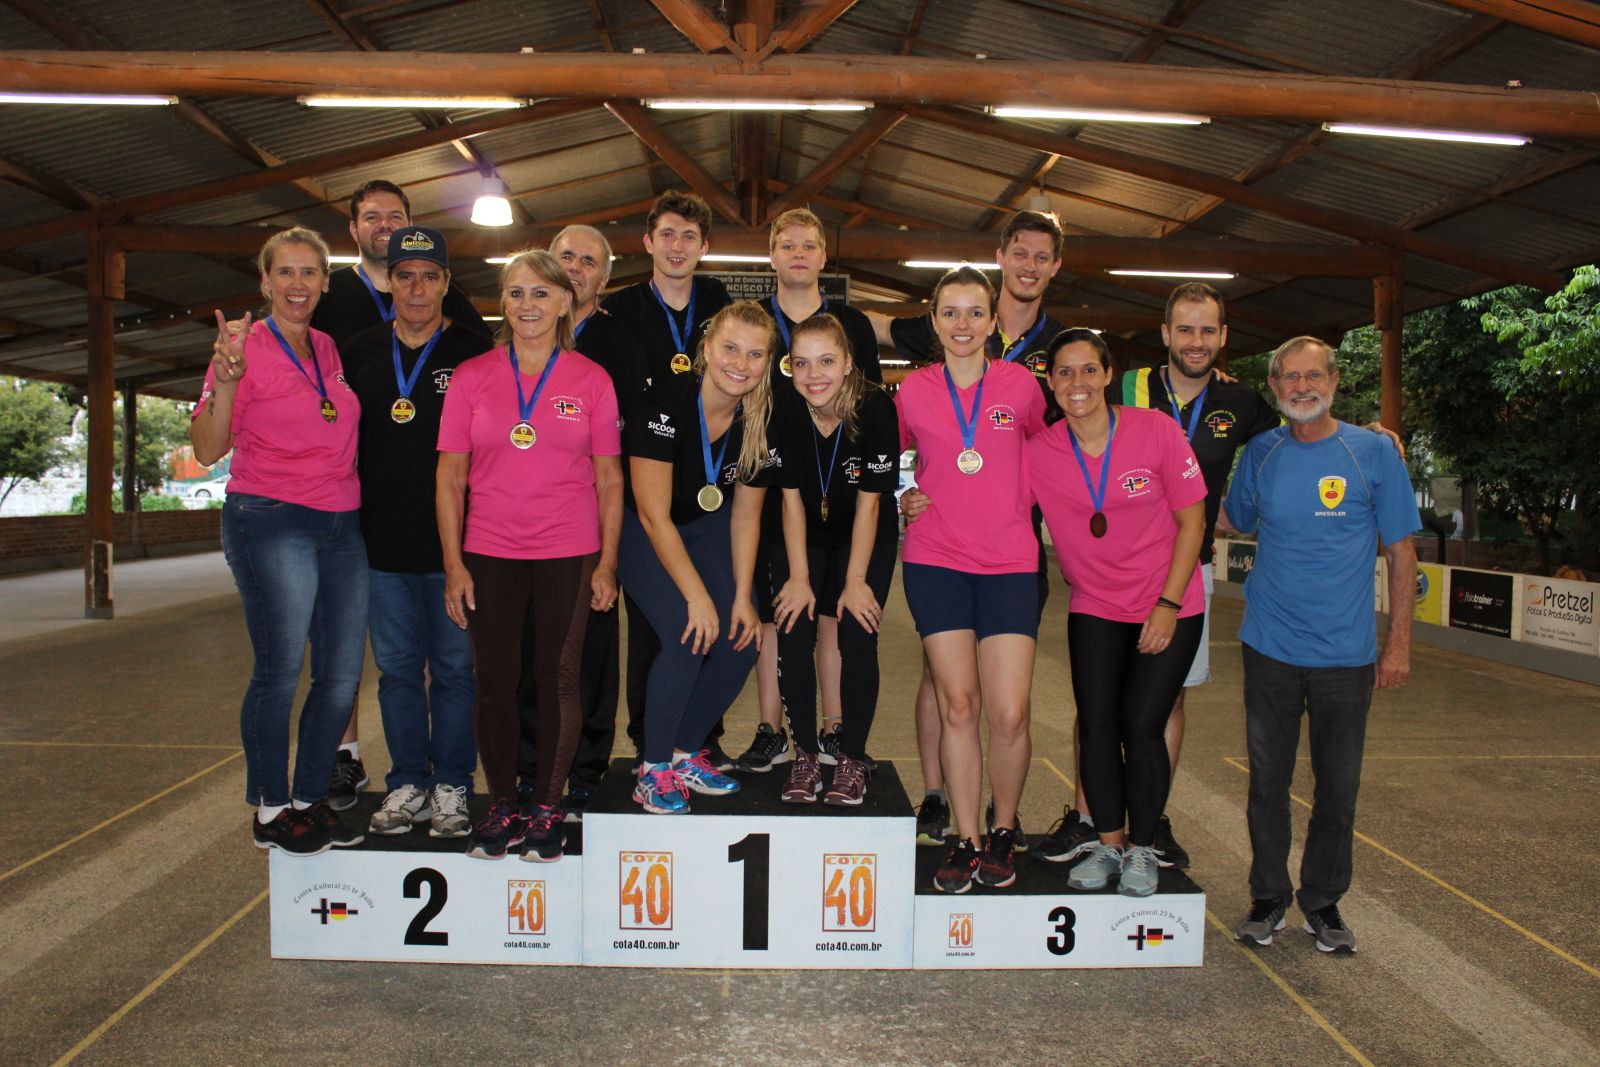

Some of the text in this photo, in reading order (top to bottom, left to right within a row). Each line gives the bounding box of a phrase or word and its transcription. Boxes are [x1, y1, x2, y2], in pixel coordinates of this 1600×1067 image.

[726, 284, 763, 292] NCISCO
[648, 421, 676, 434] SICOOB
[867, 461, 893, 470] SICOOB
[1543, 585, 1594, 613] Pretzel
[1527, 606, 1593, 625] Fotos & Produção Digital
[622, 855, 670, 863] COTA
[826, 857, 873, 865] COTA
[313, 882, 341, 891] Cultural
[728, 833, 770, 950] 1
[621, 863, 671, 926] 40
[825, 866, 873, 927] 40
[403, 867, 448, 946] 2
[510, 889, 544, 931] 40
[1131, 910, 1158, 918] Cultural
[950, 918, 972, 945] 40
[1046, 906, 1076, 955] 3
[504, 941, 551, 949] cota40.com.br
[613, 940, 680, 950] cota40.com.br
[816, 941, 882, 951] cota40.com.br
